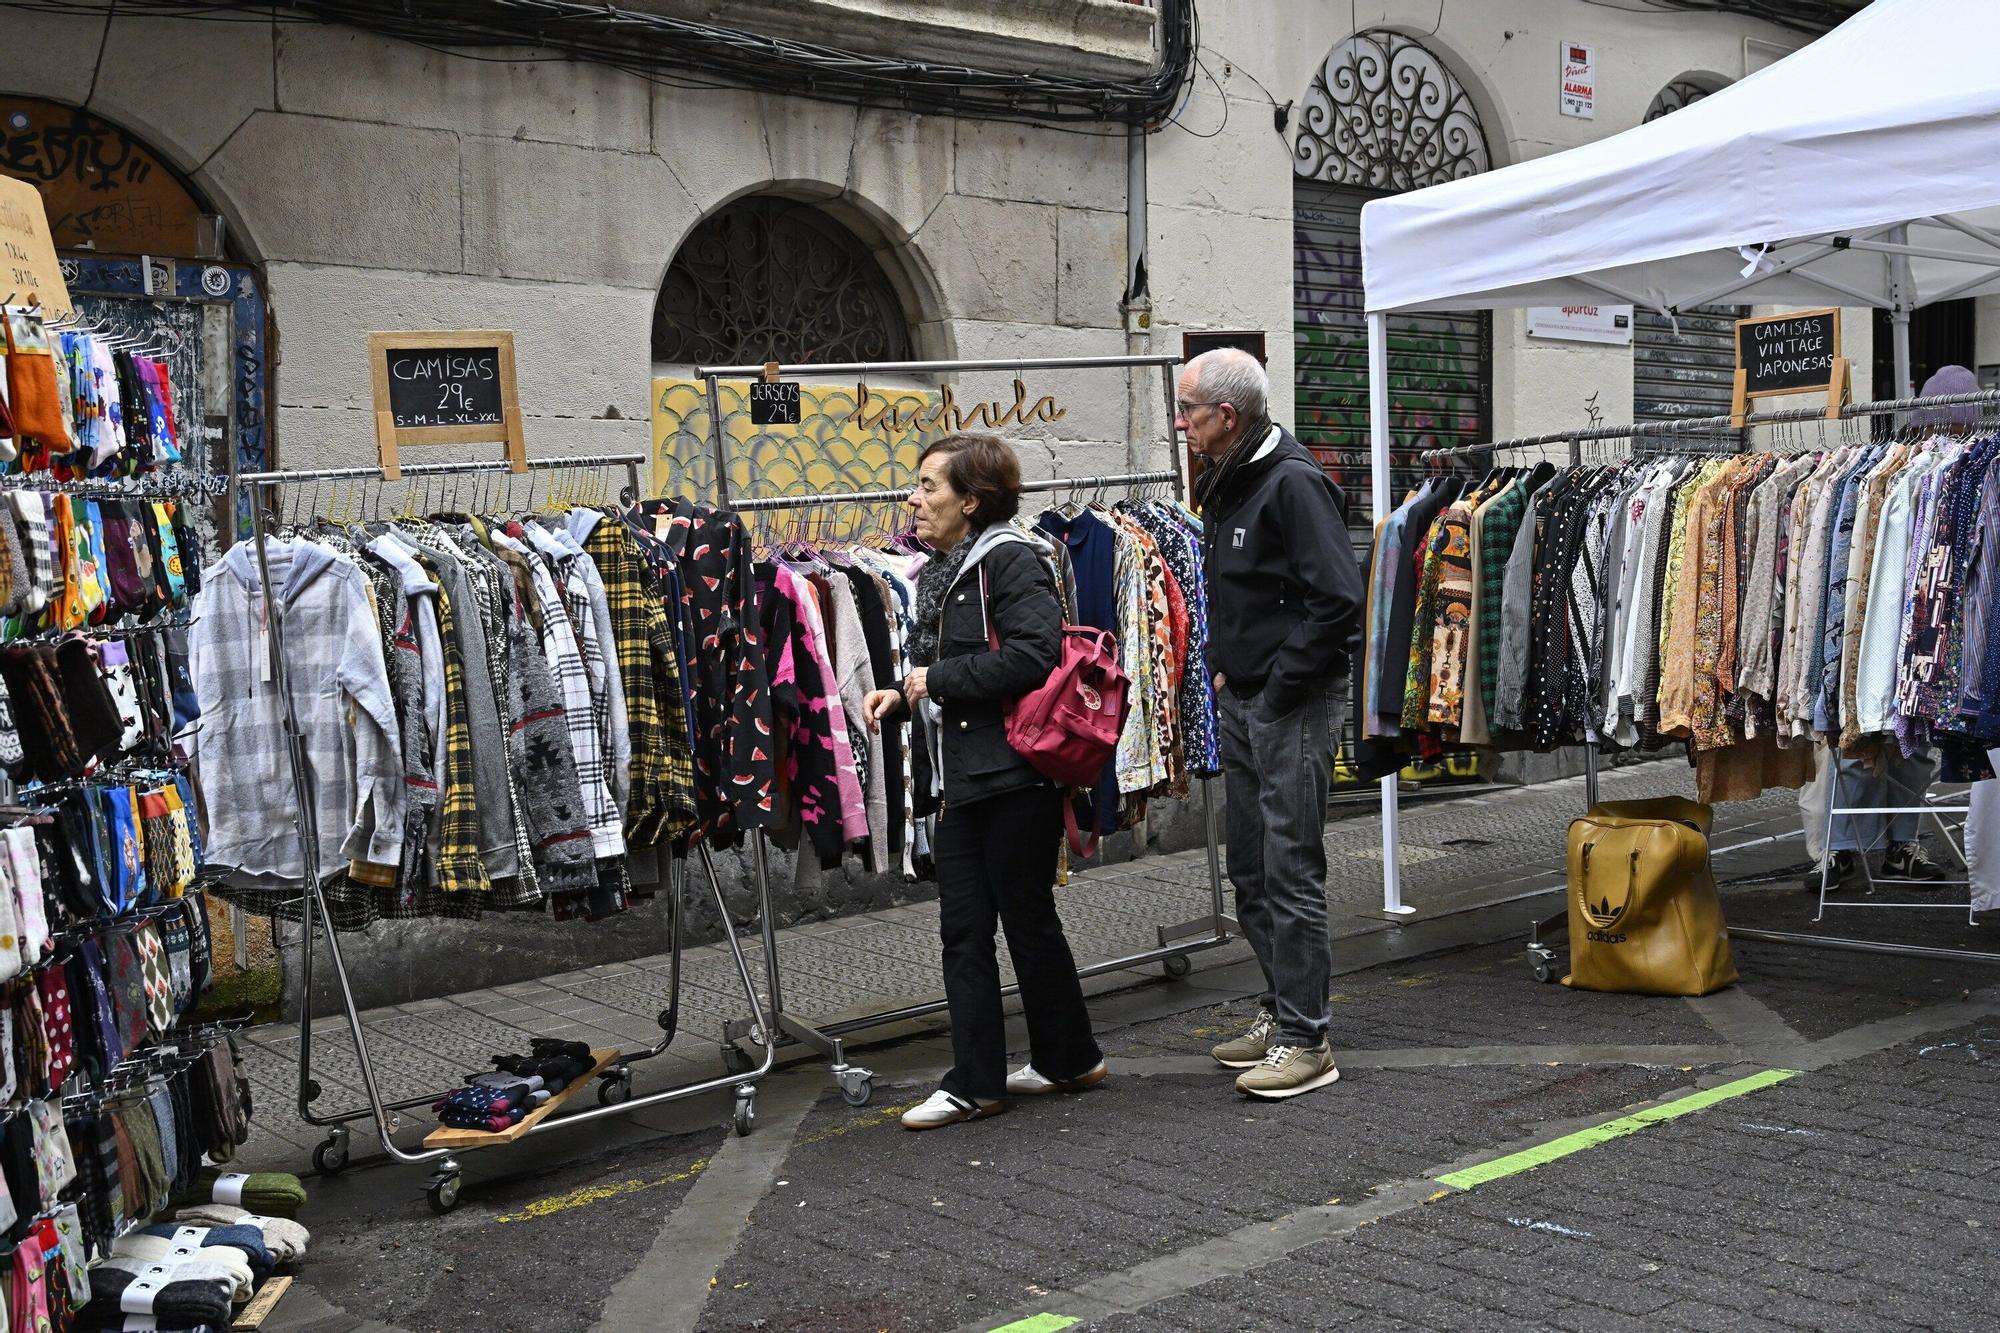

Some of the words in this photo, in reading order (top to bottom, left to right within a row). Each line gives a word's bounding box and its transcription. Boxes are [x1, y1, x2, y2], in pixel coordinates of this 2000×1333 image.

[1564, 82, 1592, 96] ALARMA
[1754, 319, 1821, 341] CAMISAS
[1758, 336, 1824, 358] VINTAGE
[1756, 354, 1834, 379] JAPONESAS
[436, 382, 474, 411] 29€
[752, 383, 799, 403] JERSEYS
[768, 403, 797, 423] 29€
[847, 378, 1067, 433] lachula
[1587, 930, 1627, 944] adidas
